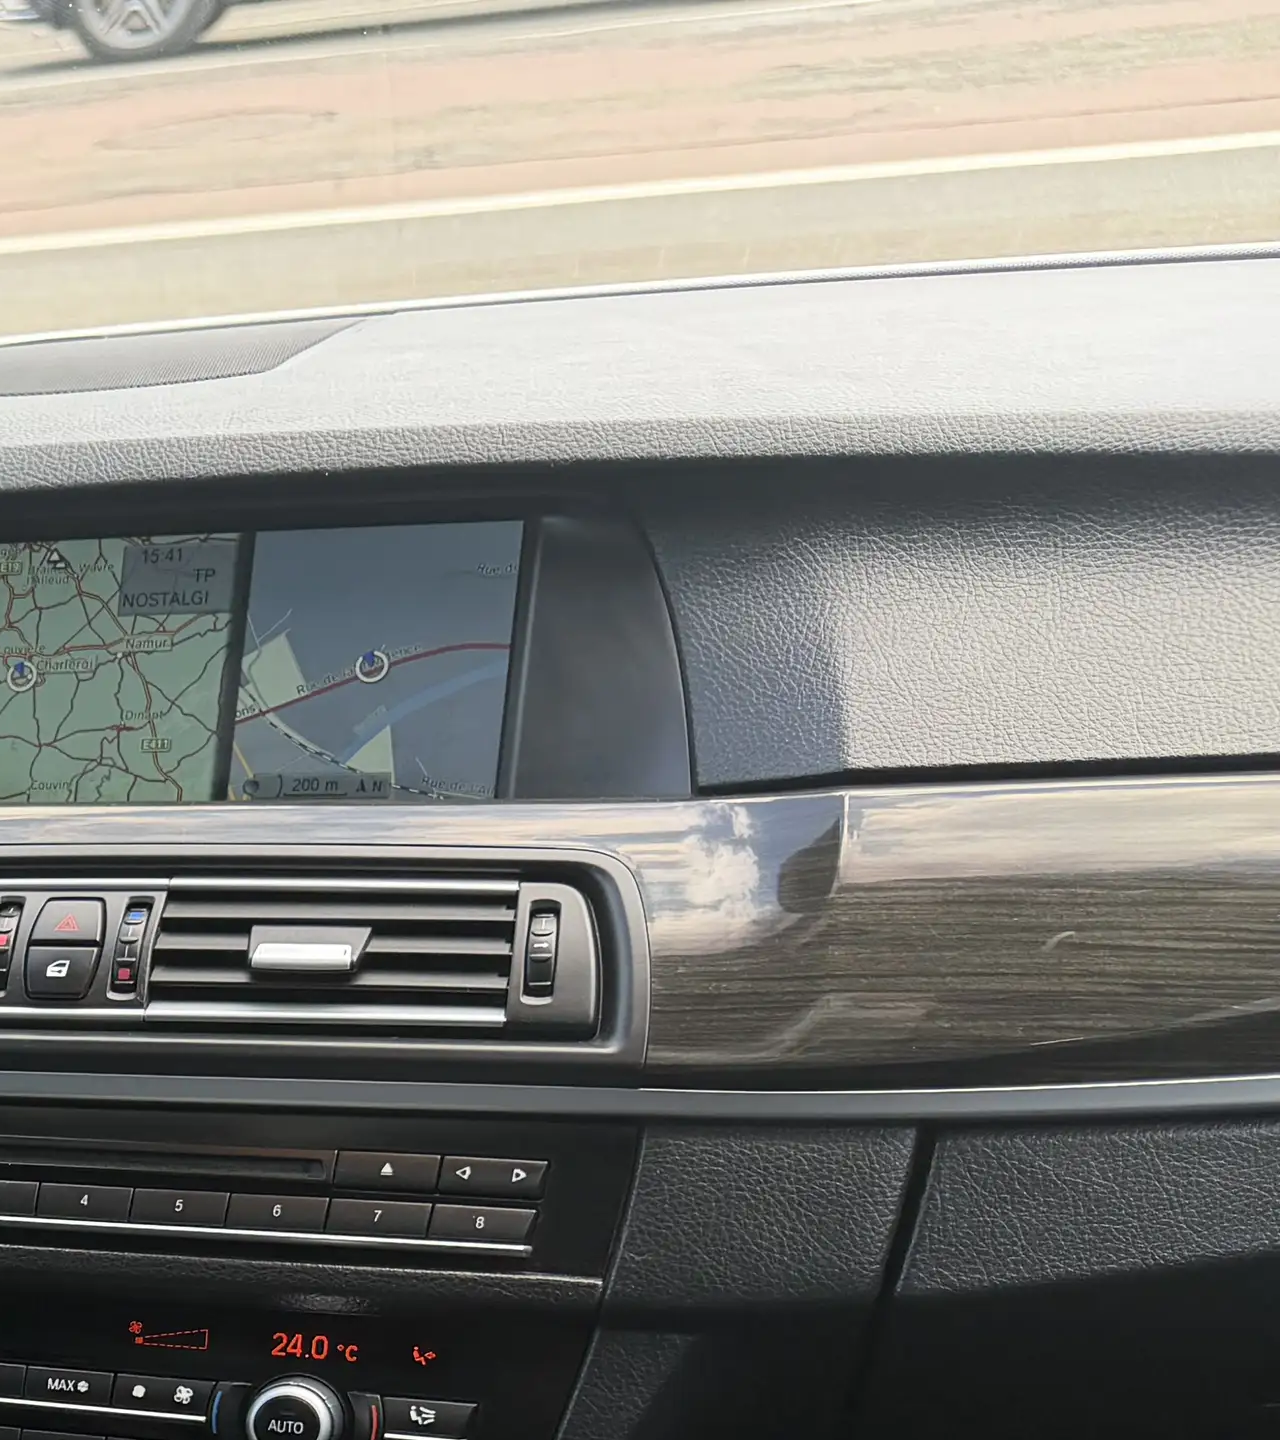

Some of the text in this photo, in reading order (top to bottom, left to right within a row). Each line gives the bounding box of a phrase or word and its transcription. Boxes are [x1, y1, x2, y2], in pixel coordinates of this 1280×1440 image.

[142, 549, 182, 564] 15:41
[0, 562, 19, 573] E19
[195, 568, 215, 582] TP
[122, 591, 209, 608] NOSTALGI
[126, 637, 168, 649] Namur
[37, 658, 93, 671] Charleroi
[142, 739, 168, 750] E411
[31, 780, 69, 791] Couvin
[291, 778, 339, 792] 200 m
[80, 1194, 89, 1206] 4
[174, 1199, 184, 1212] 5
[272, 1204, 282, 1218] 6
[374, 1209, 382, 1223] 7
[475, 1216, 485, 1230] 8
[271, 1332, 329, 1360] 24.0
[47, 1378, 75, 1393] MAX
[267, 1418, 305, 1435] AUTO
